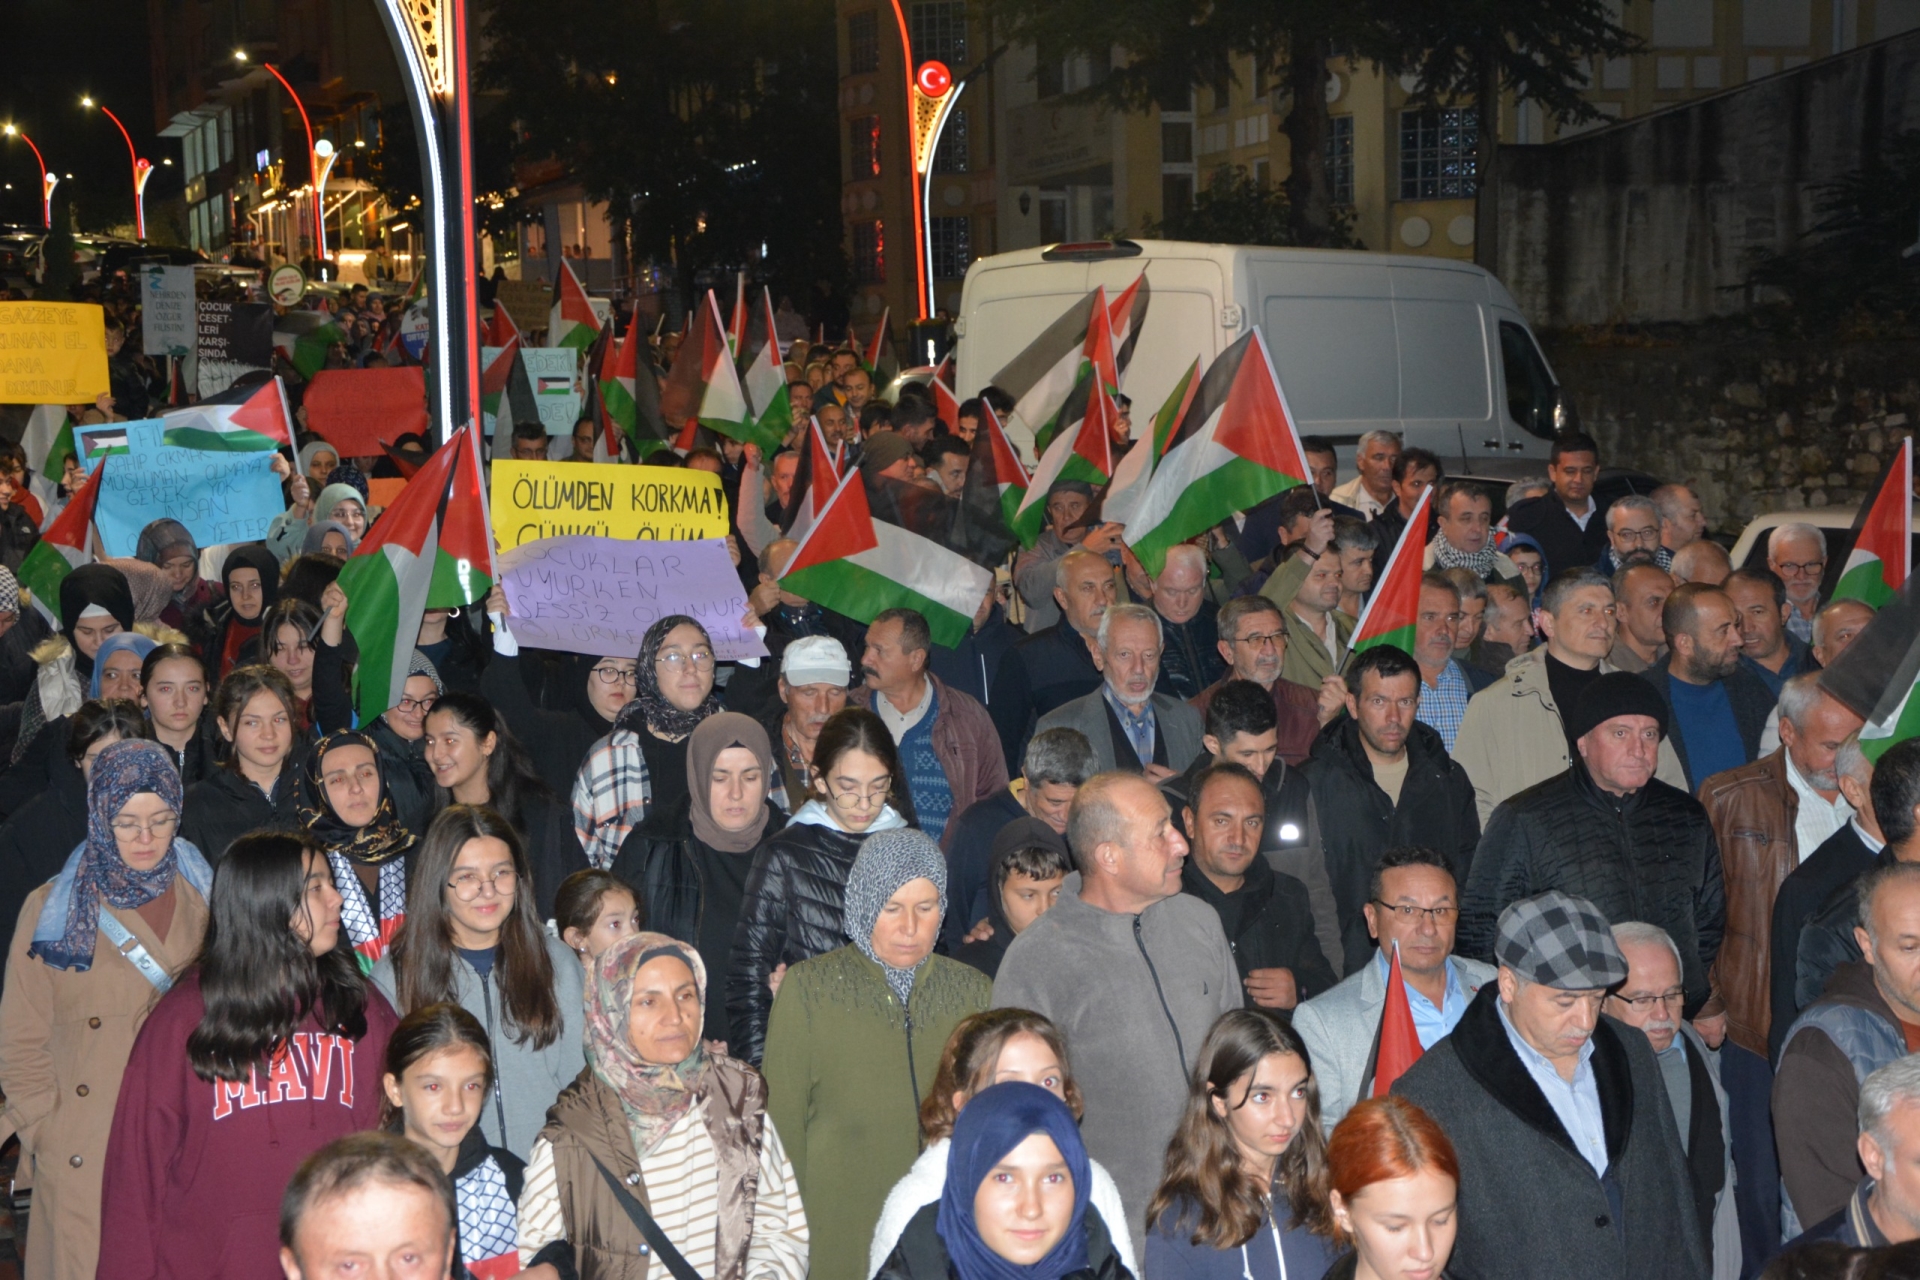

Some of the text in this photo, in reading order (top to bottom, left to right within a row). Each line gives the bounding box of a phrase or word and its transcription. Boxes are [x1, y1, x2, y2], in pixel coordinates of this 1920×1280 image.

[199, 301, 232, 312] ÇOCUK
[199, 313, 233, 323] CESET-
[198, 324, 219, 335] LERİ
[64, 331, 87, 349] EL
[198, 336, 231, 348] KARŞI-
[198, 348, 227, 358] SINDA
[205, 458, 262, 481] OLMAYA
[127, 478, 241, 506] GEREK YOK
[513, 473, 723, 519] ÖLÜMDEN KORKMA!
[208, 517, 268, 542] YETER
[515, 567, 659, 601] UYURKEN
